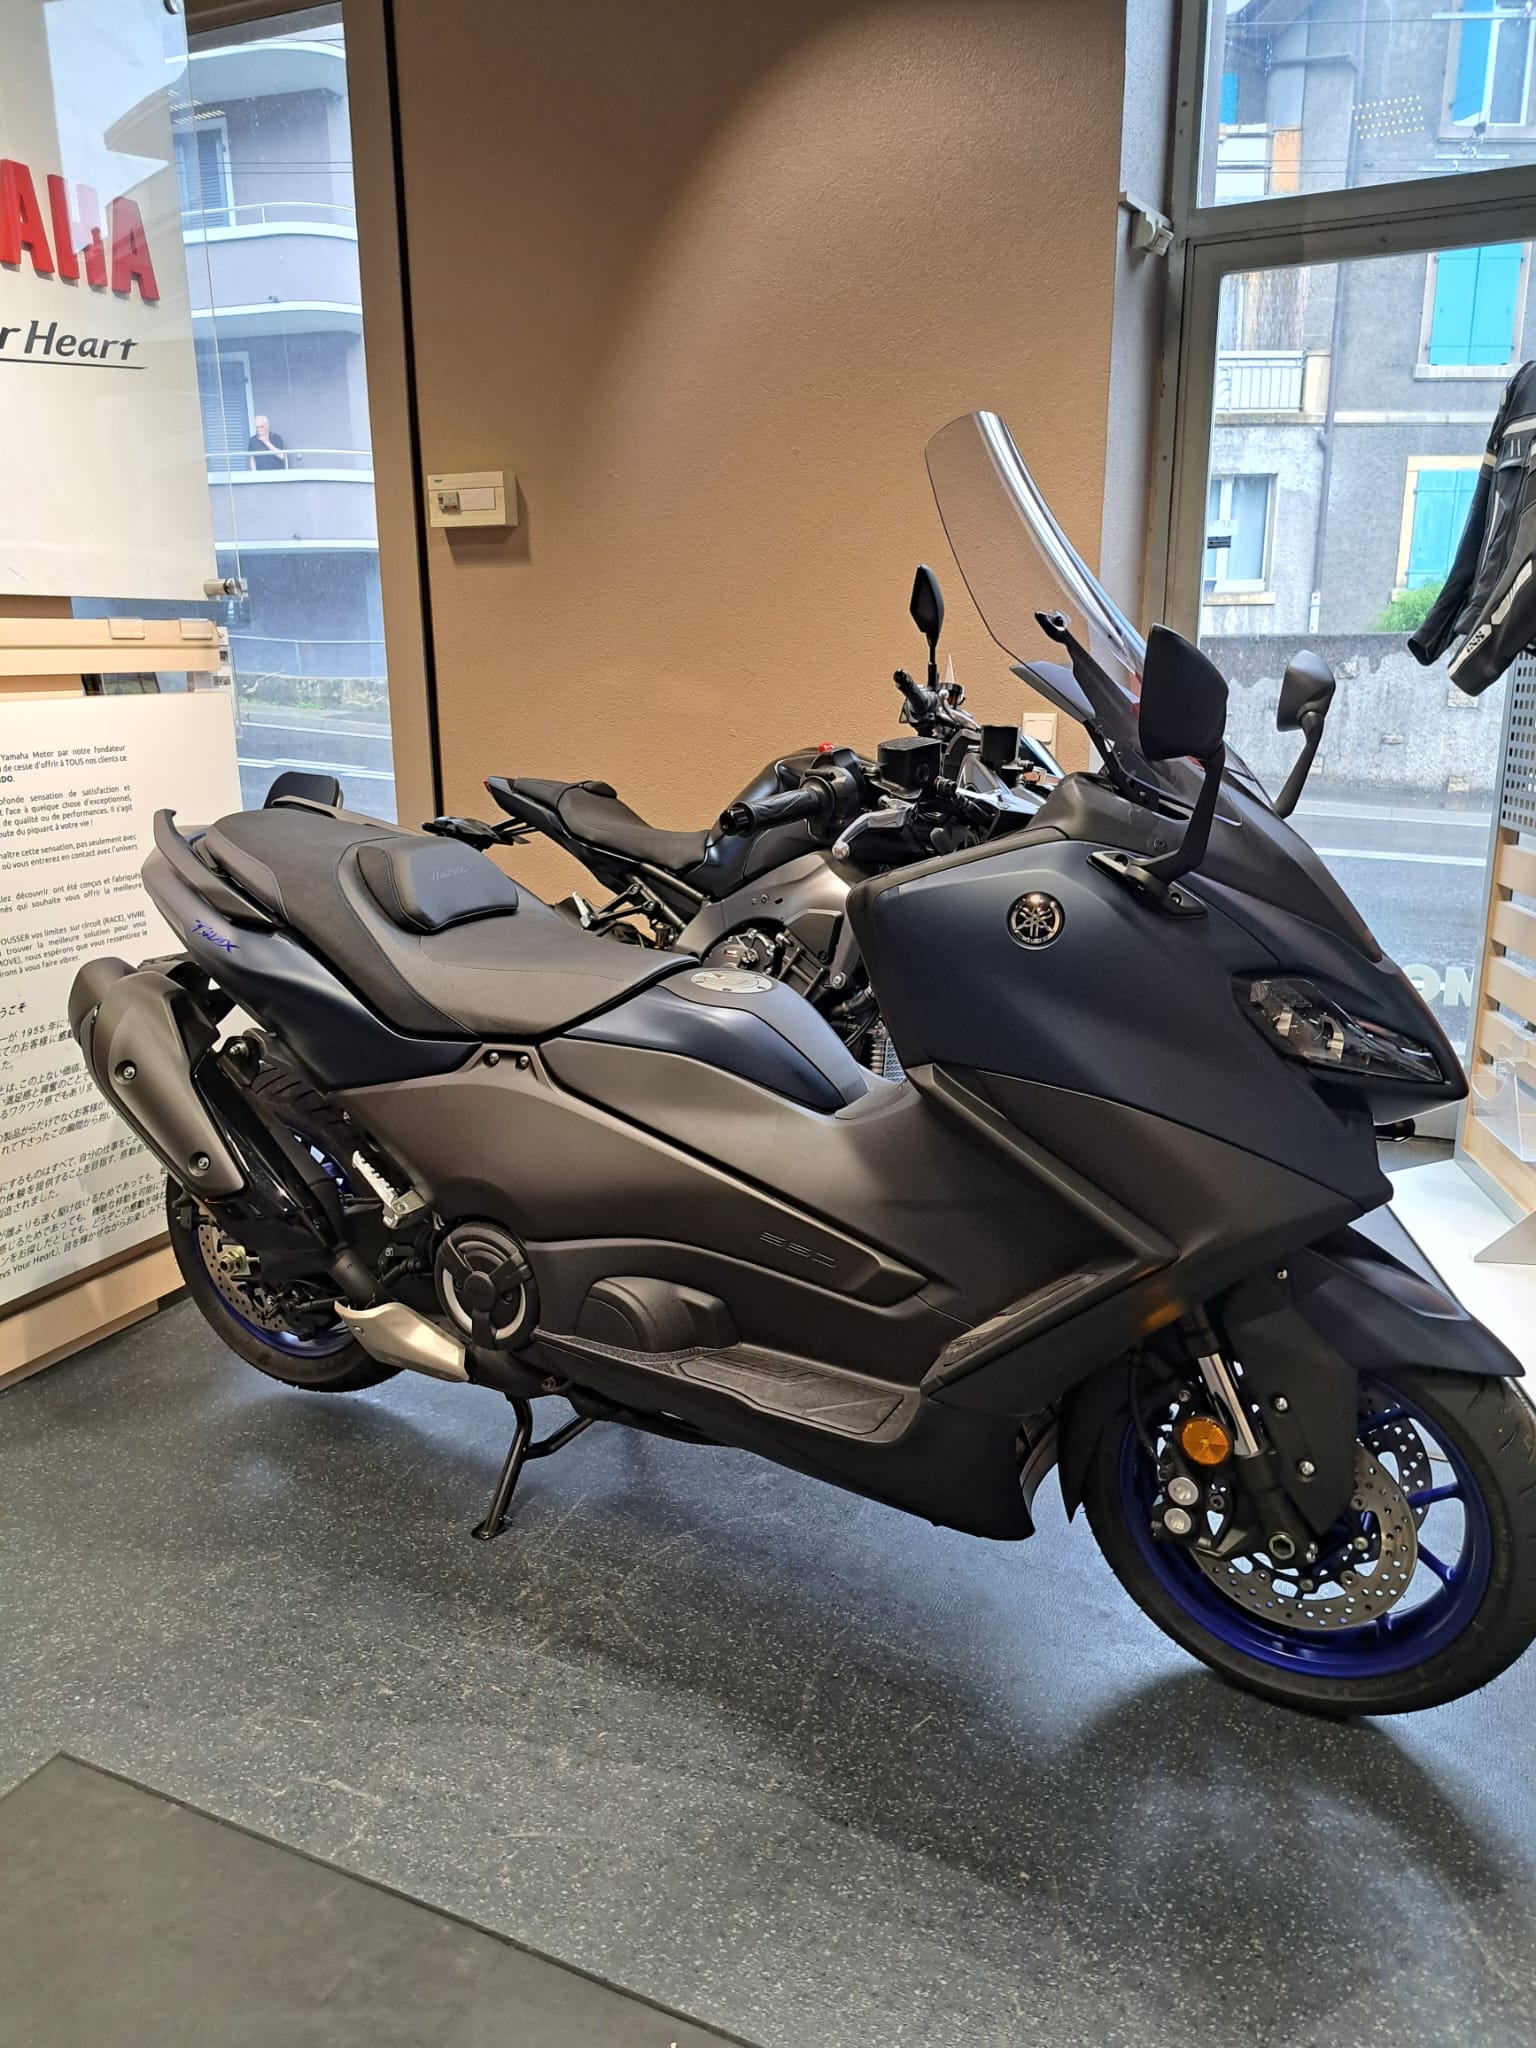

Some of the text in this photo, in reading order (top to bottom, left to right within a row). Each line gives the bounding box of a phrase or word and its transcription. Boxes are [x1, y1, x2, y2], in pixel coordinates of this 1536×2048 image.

[24, 320, 138, 361] Heart
[1, 745, 125, 761] Yamaha Motor par notre fondateur
[3, 764, 12, 772] de
[14, 763, 33, 771] cesse
[66, 758, 84, 767] TOUS
[98, 755, 119, 764] clients
[0, 775, 15, 784] DO.
[30, 792, 63, 802] sensation
[69, 789, 77, 798] de
[82, 785, 119, 797] satisfaction
[124, 784, 131, 792] et
[6, 807, 21, 816] face
[31, 804, 59, 814] quelque
[62, 801, 81, 810] chose
[3, 819, 12, 827] de
[14, 815, 38, 826] qualité
[52, 813, 60, 821] de
[16, 828, 25, 836] du
[27, 825, 54, 836] piquant
[60, 822, 78, 830] votre
[80, 819, 89, 827] vie
[21, 848, 39, 857] cette
[76, 842, 87, 850] pas
[89, 836, 121, 847] seulement
[31, 856, 60, 866] entrerez
[71, 850, 96, 859] contact
[97, 848, 111, 856] avec
[16, 888, 48, 900] découvrir
[17, 902, 27, 911] qui
[32, 897, 60, 908] souhaite
[65, 894, 80, 902] vous
[114, 883, 142, 893] meilleure
[44, 927, 67, 937] limites
[127, 910, 146, 920] VIVRE
[7, 921, 147, 955] trouver la meilleure solution pour vous
[25, 953, 41, 961] nous
[76, 943, 88, 951] que
[90, 940, 105, 948] vous
[24, 964, 40, 972] vous
[42, 959, 57, 969] faire
[22, 1024, 45, 1038] 1955
[12, 1260, 31, 1273] Your
